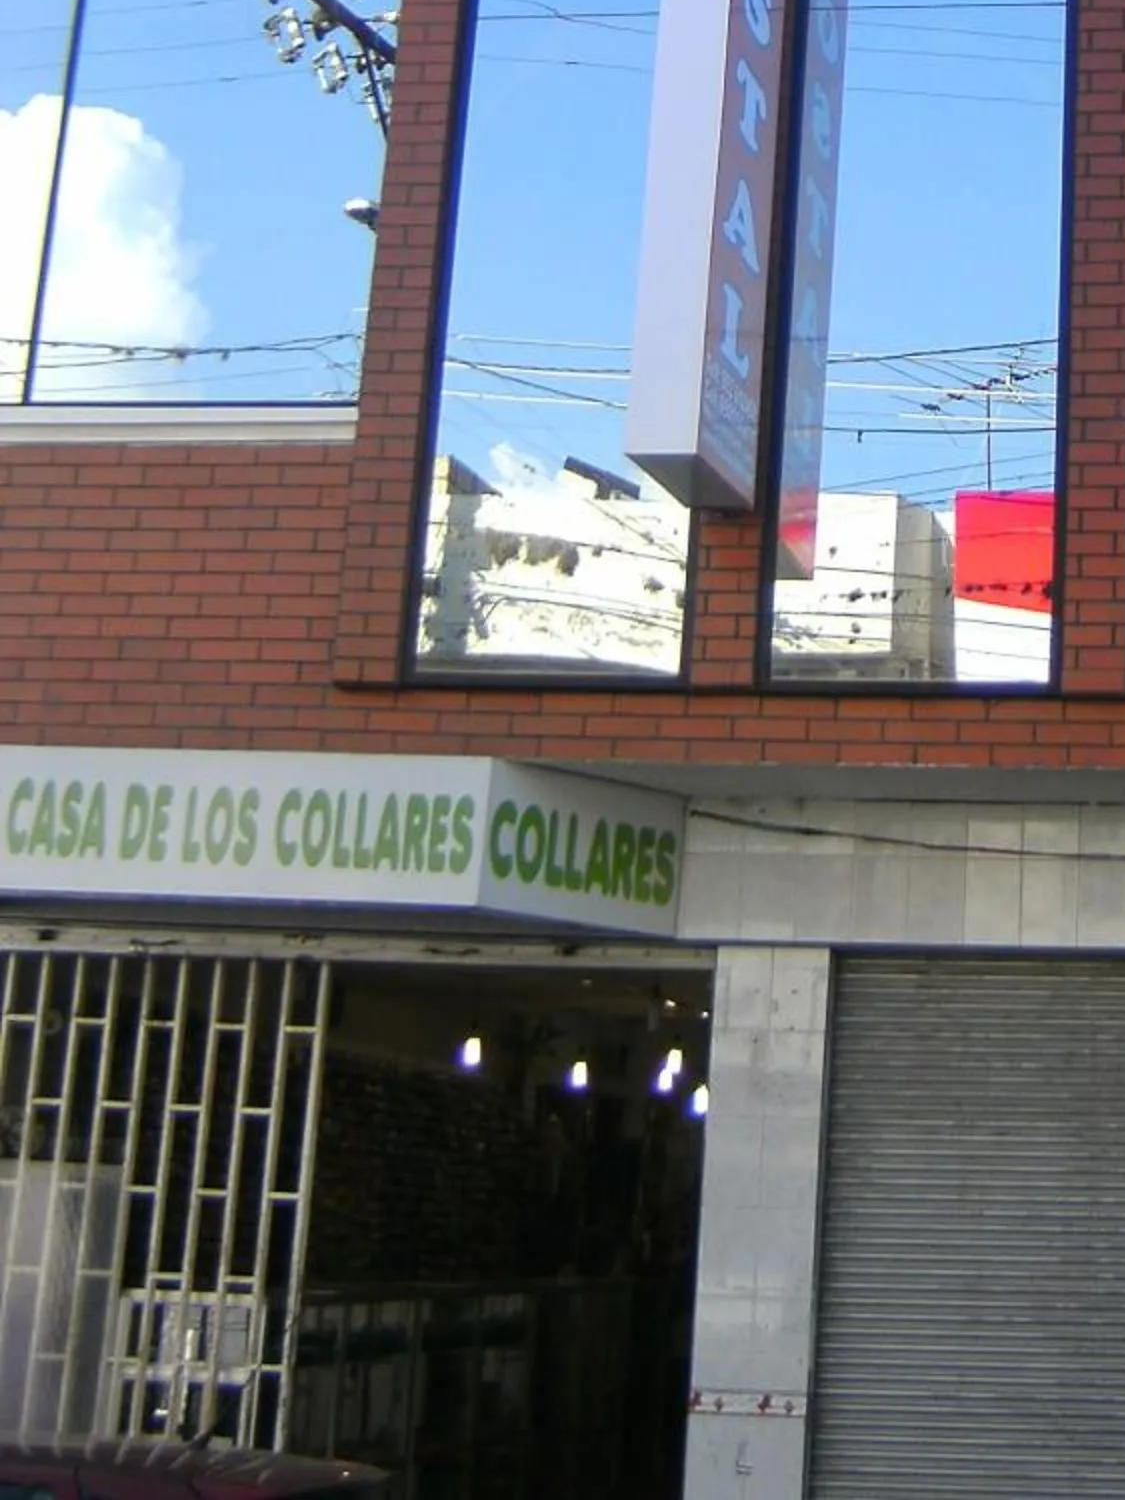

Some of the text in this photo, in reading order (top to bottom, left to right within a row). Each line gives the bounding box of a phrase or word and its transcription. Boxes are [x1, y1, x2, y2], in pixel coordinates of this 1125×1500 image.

[7, 777, 475, 875] CASA DE LOS COLLARES
[490, 799, 677, 906] COLLARES
